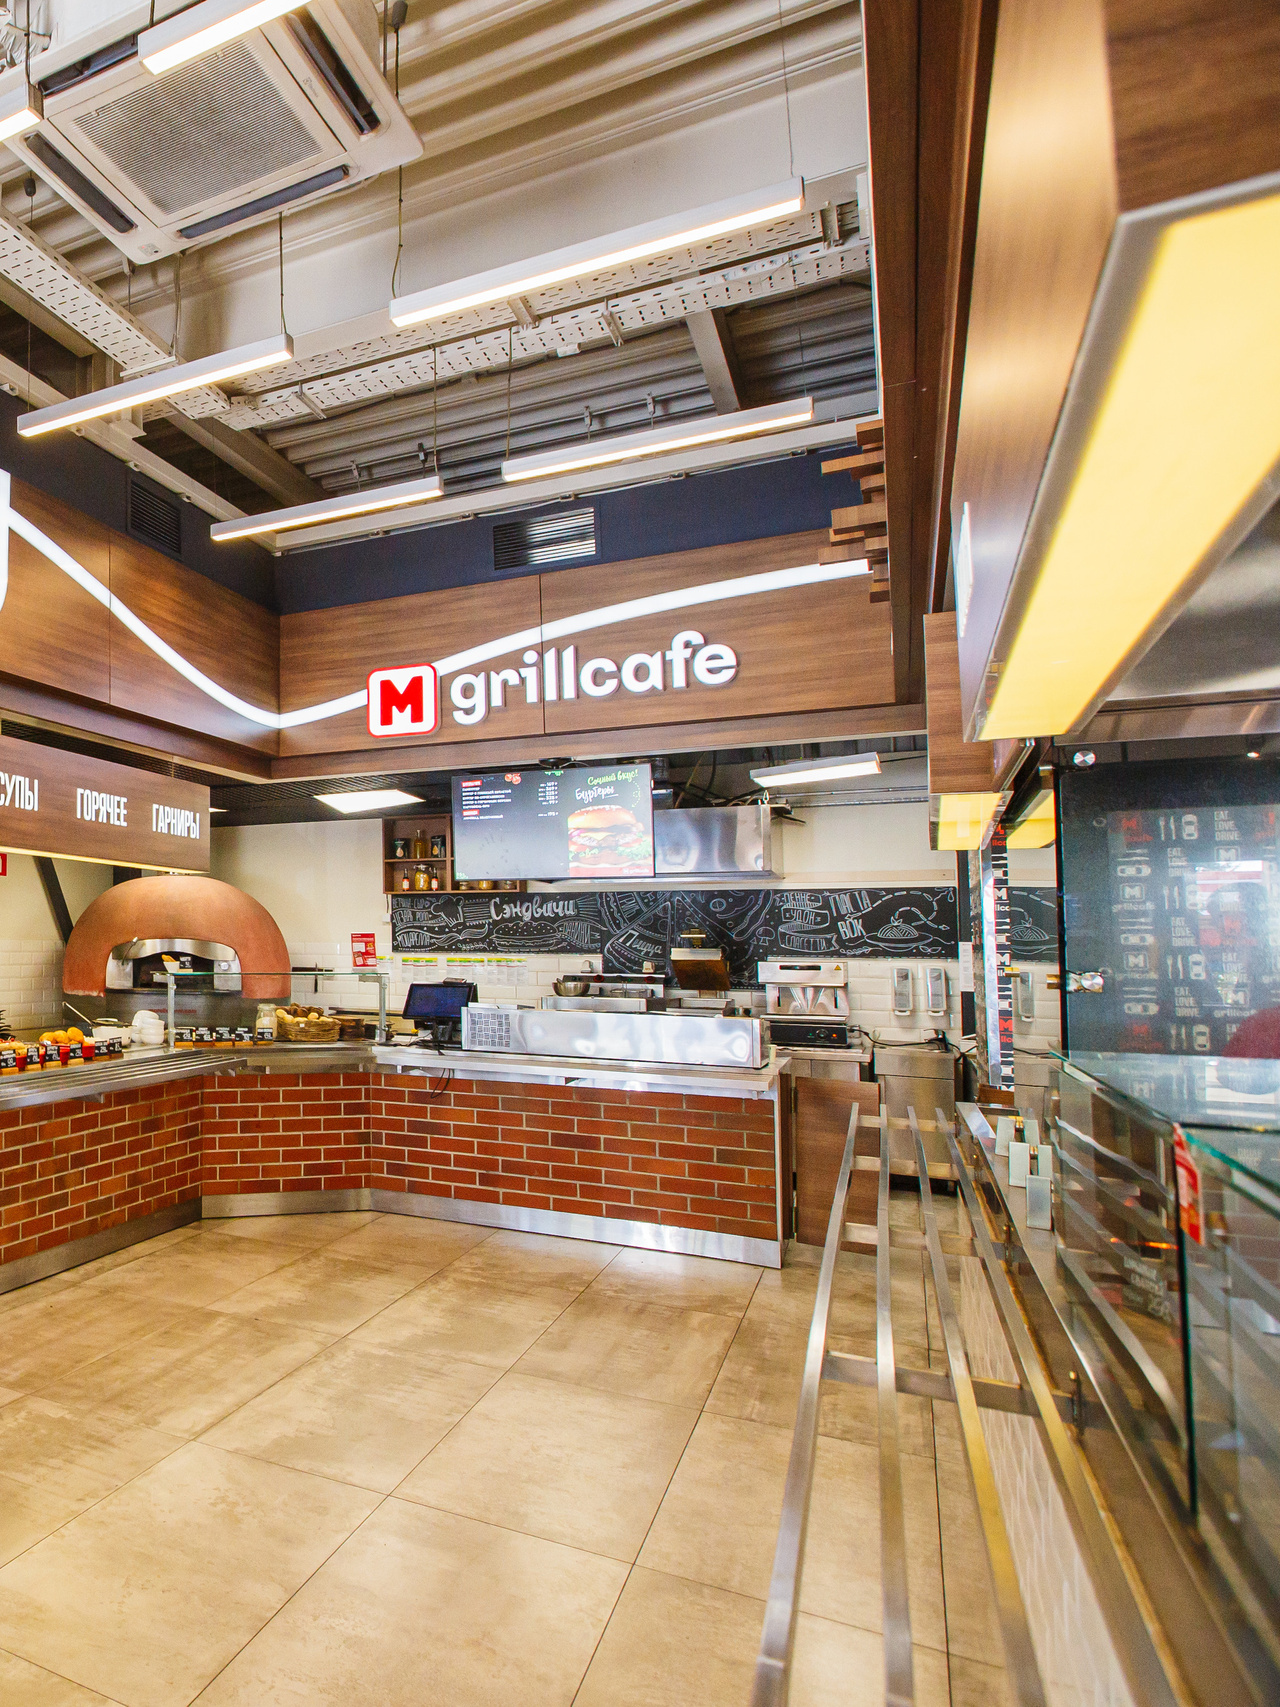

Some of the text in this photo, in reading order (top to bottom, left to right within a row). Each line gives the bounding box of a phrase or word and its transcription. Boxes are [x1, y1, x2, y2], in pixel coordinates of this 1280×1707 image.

[379, 630, 740, 727] M grillcafe
[575, 785, 616, 804] Бургеры
[76, 787, 128, 827] ГОРЯЧЕЕ
[152, 803, 200, 840] ГАРНИРЫ
[489, 895, 578, 922] Сэндвичи
[837, 918, 867, 940] ВОК
[619, 929, 663, 957] Пицца
